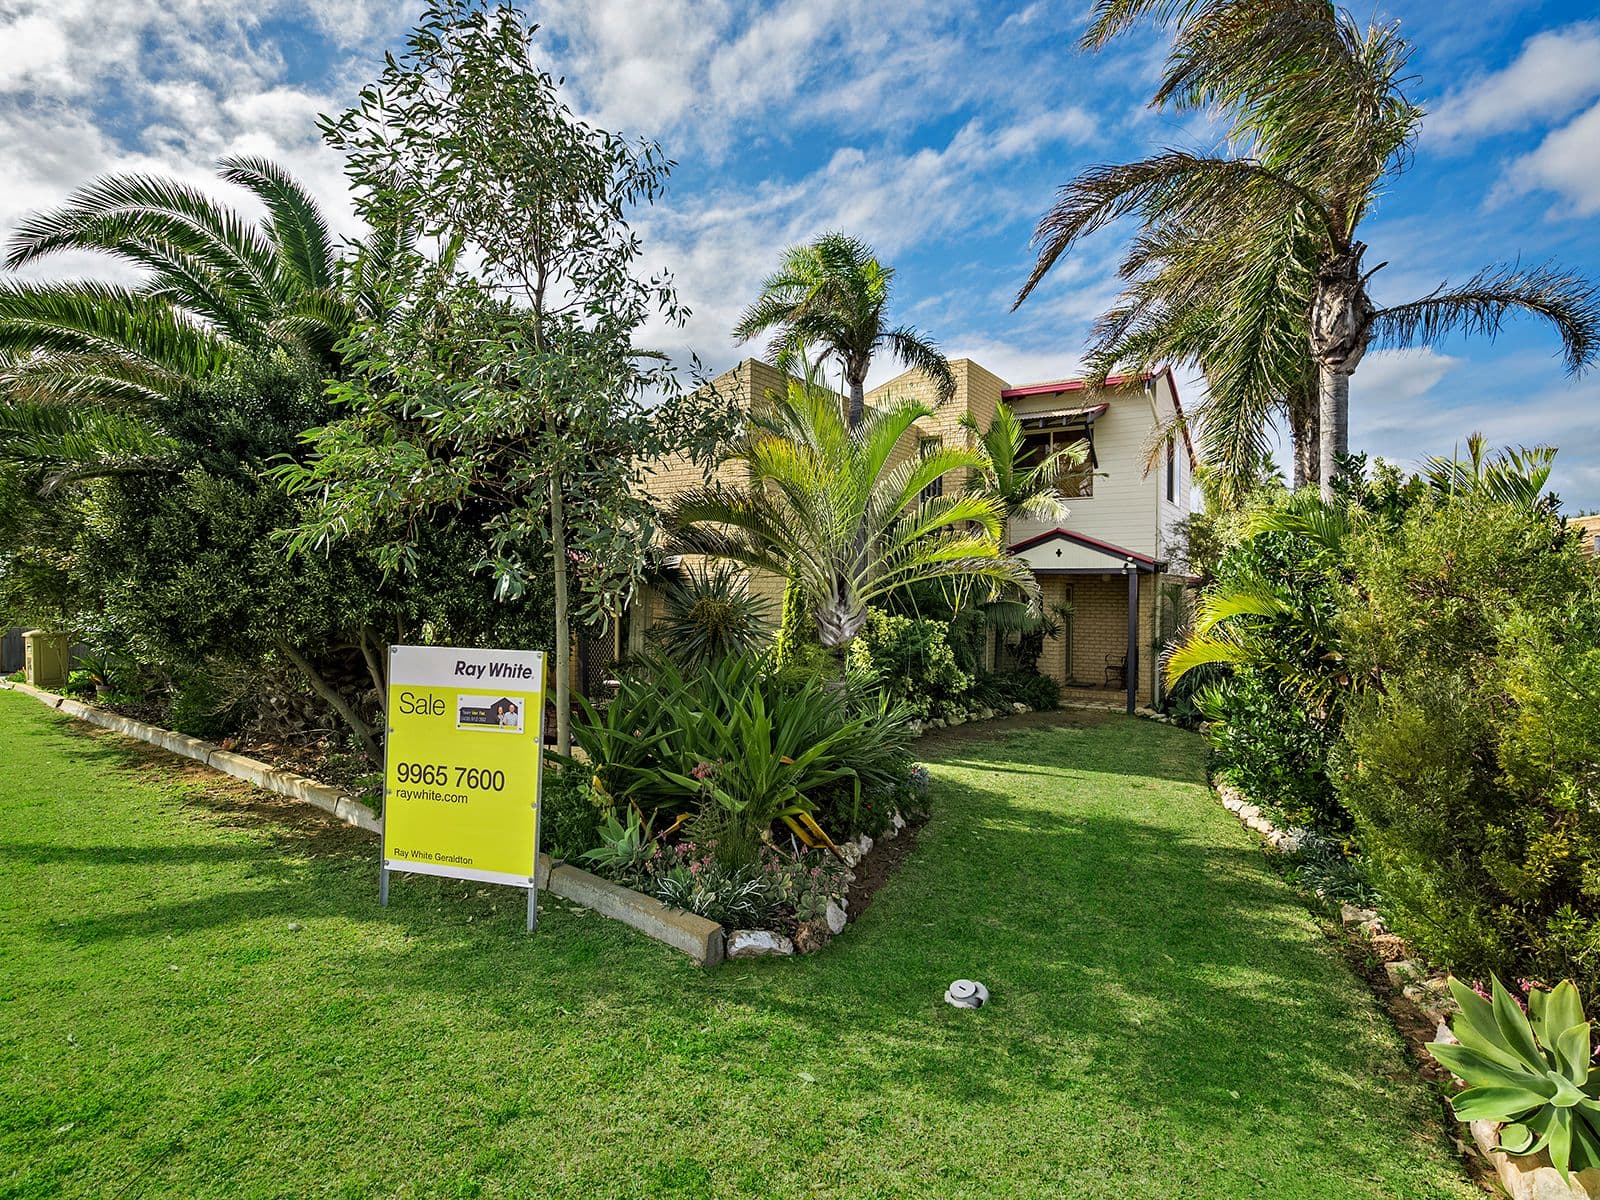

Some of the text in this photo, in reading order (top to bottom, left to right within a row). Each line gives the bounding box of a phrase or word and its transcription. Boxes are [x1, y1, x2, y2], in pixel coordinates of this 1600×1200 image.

[454, 660, 532, 679] Ray White
[399, 692, 446, 716] Sale
[397, 762, 505, 792] 9965 7600
[396, 788, 468, 804] raywhite.com
[393, 848, 473, 865] Ray White Geraldton
